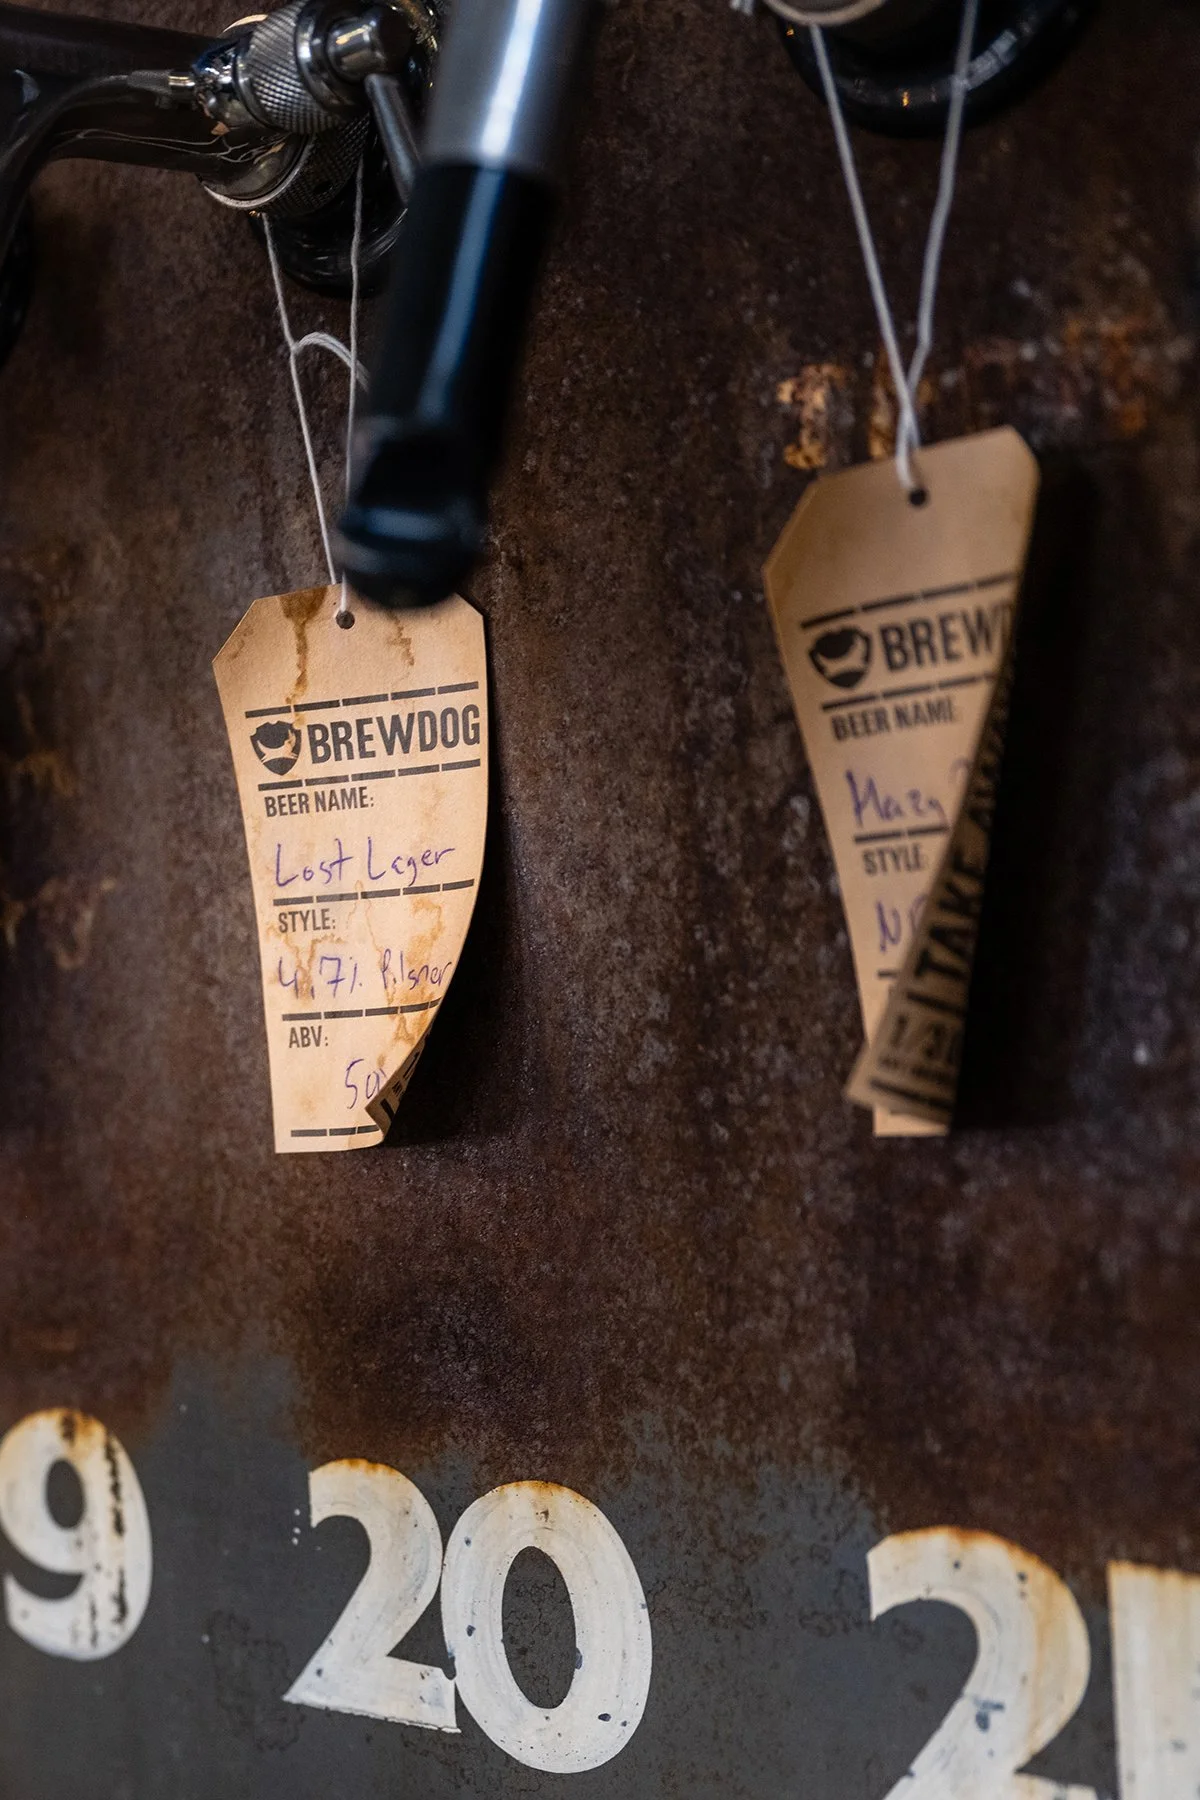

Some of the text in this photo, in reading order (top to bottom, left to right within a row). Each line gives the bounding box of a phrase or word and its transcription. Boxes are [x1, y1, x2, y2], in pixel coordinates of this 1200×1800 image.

[307, 704, 481, 765] BREWDOG
[832, 708, 891, 742] BEER
[265, 786, 375, 818] BEER NAME:
[275, 838, 353, 887] Lost
[278, 909, 336, 934] STYLE:
[288, 1025, 329, 1048] ABV:
[282, 1458, 653, 1774] 20
[866, 1526, 1200, 1800] 21
